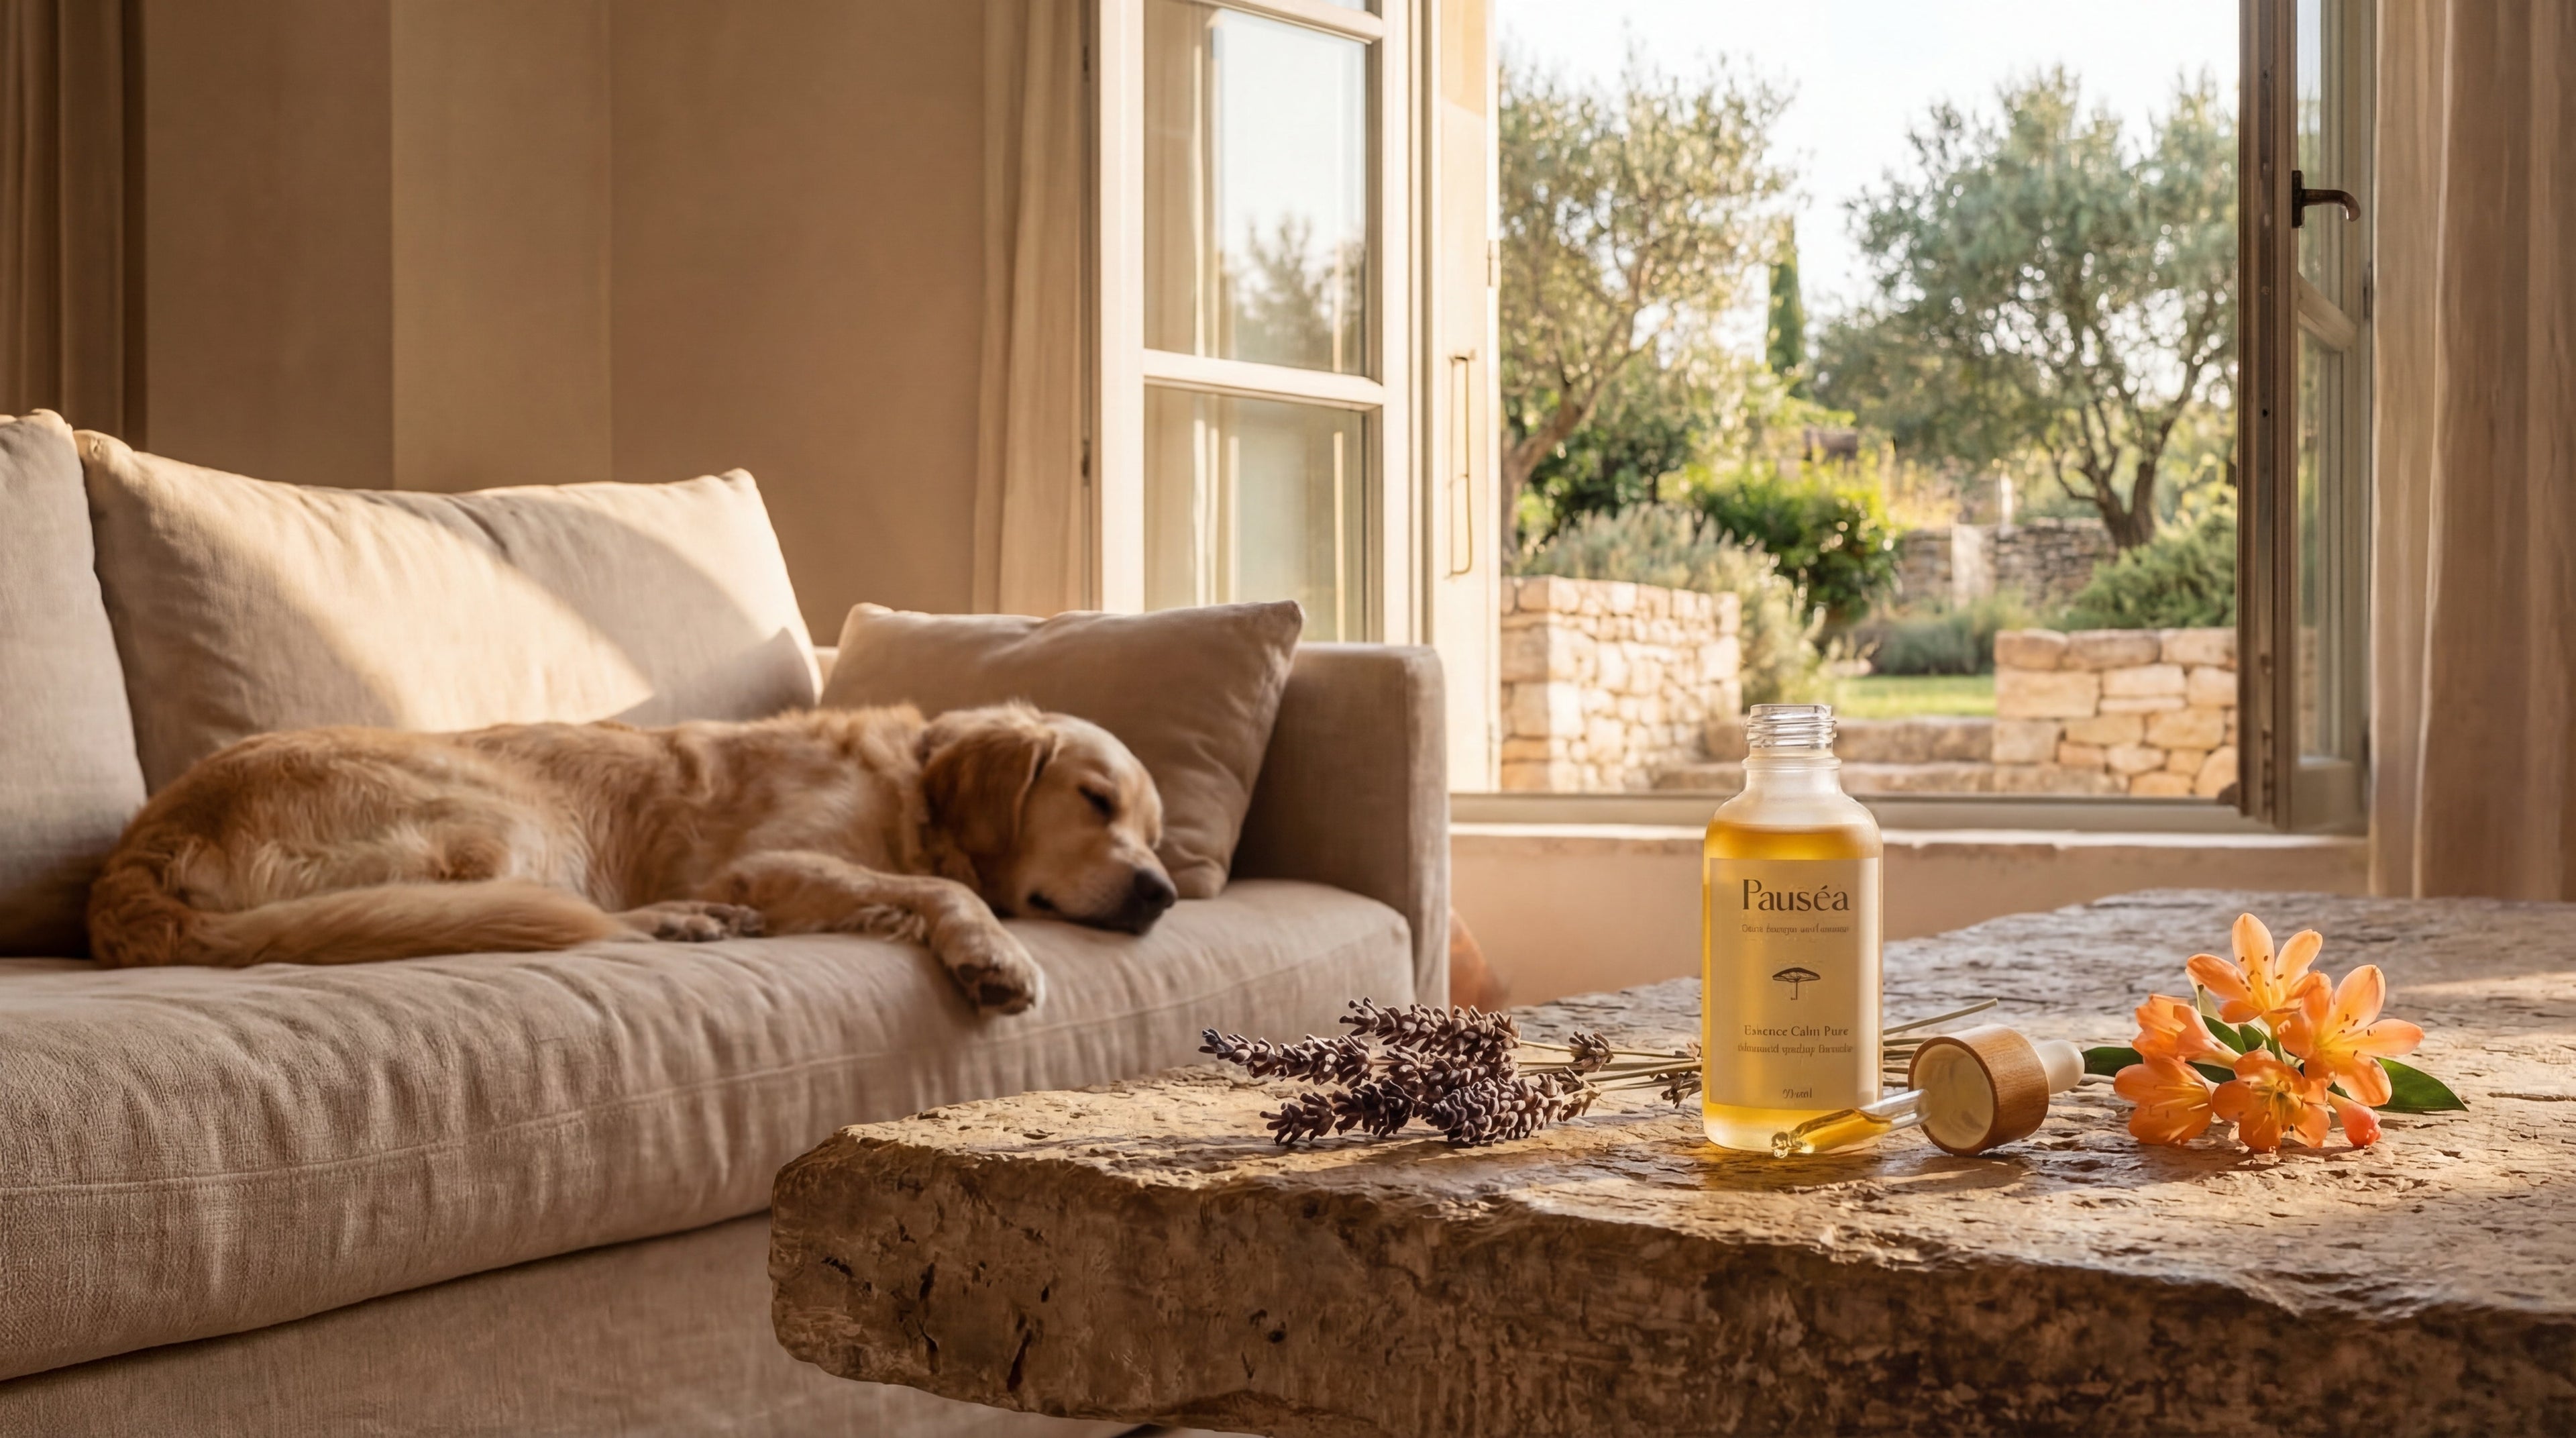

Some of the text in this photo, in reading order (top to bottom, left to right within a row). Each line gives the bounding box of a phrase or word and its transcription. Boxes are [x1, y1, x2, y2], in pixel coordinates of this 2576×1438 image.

[1743, 879, 1850, 911] Pauséa
[1791, 1025, 1820, 1036] Calm
[1825, 1025, 1849, 1036] Pure
